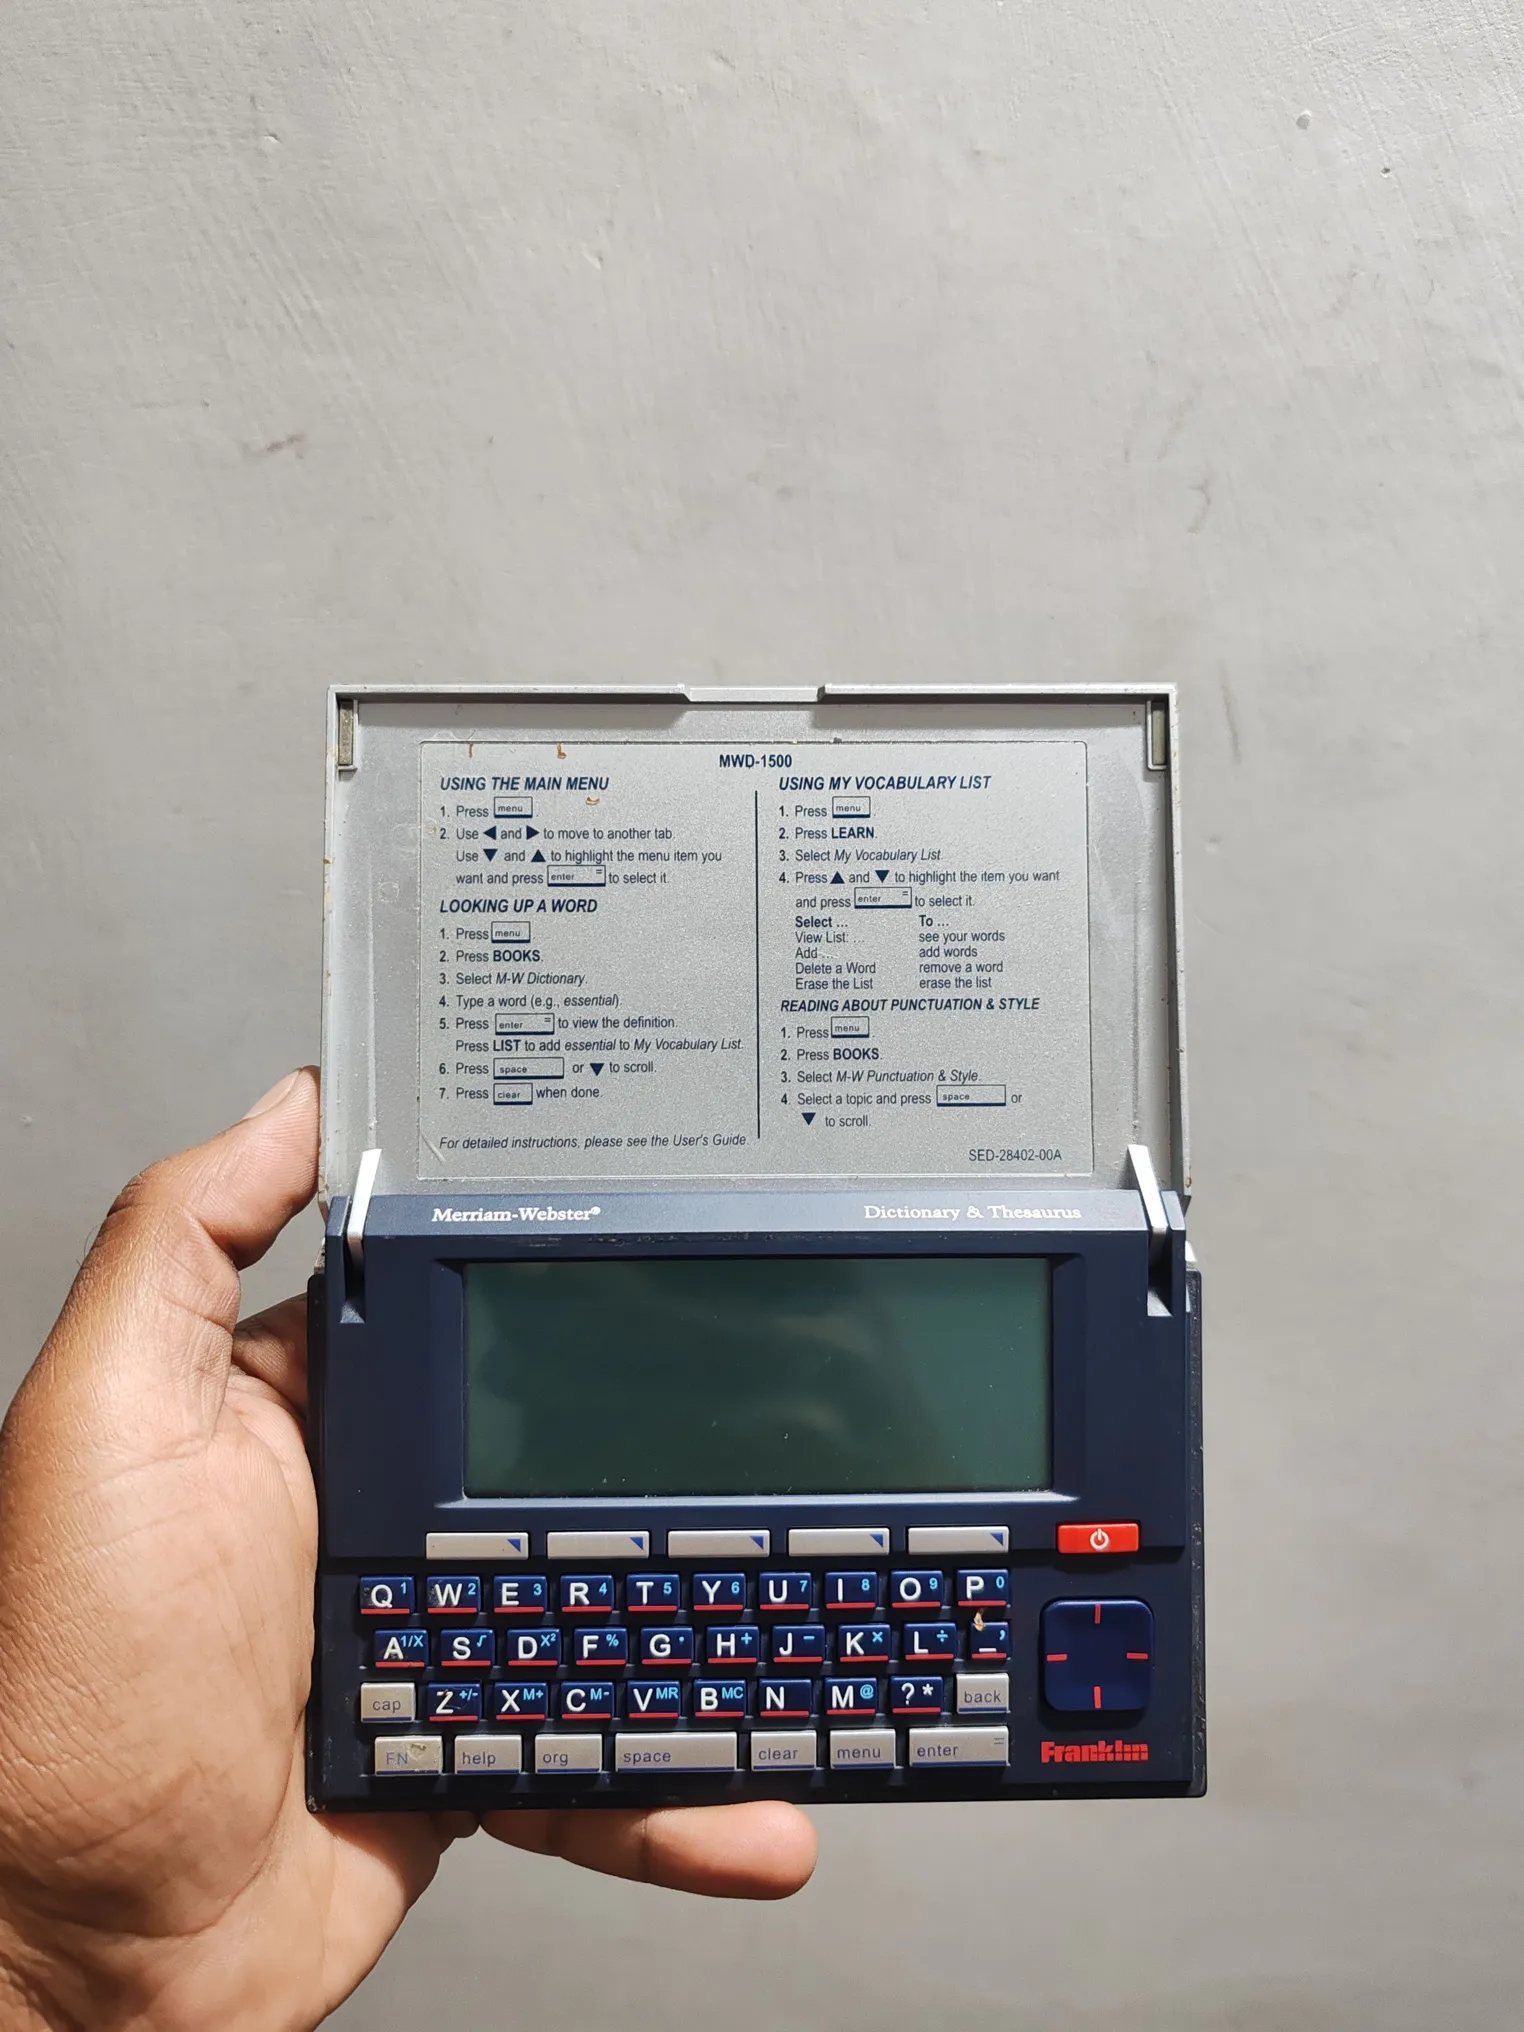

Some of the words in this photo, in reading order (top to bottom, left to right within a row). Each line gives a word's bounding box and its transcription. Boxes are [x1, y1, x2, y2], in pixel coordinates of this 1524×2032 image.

[719, 754, 793, 768] MWD-1500
[441, 777, 486, 790] USING
[491, 777, 520, 790] THE
[524, 777, 562, 790] MAIN
[566, 777, 609, 790] MENU
[779, 777, 824, 790] USING
[829, 777, 851, 790] MY
[855, 776, 956, 790] VOCABULARY
[959, 775, 991, 789] LIST
[456, 805, 489, 818] Press
[498, 805, 523, 813] menu
[795, 805, 827, 817] Press
[456, 828, 479, 840] Use
[501, 828, 522, 840] and
[558, 830, 590, 839] move
[607, 828, 651, 839] another
[654, 827, 676, 839] tab.
[795, 827, 827, 839] Press
[832, 827, 877, 839] LEARN.
[456, 850, 479, 862] Use
[504, 850, 526, 862] and
[565, 850, 614, 864] highlight
[617, 850, 634, 861] the
[638, 852, 670, 861] menu
[674, 850, 698, 861] item
[702, 852, 722, 864] you
[795, 850, 830, 861] Select
[834, 850, 851, 864] My
[855, 849, 917, 864] Vocabulary
[456, 873, 483, 884] want
[487, 873, 508, 884] and
[512, 875, 544, 887] press
[551, 873, 574, 881] enter
[623, 872, 657, 884] select
[796, 872, 828, 884] Press
[849, 872, 869, 883] and
[909, 870, 956, 885] highlight
[960, 871, 978, 882] the
[981, 870, 1005, 882] item
[1009, 873, 1029, 884] you
[1032, 871, 1060, 882] want
[441, 900, 509, 913] LOOKING
[513, 900, 536, 913] UP
[537, 900, 548, 912] A
[551, 899, 598, 913] WORD
[796, 897, 817, 908] and
[821, 898, 851, 910] press
[929, 895, 962, 907] select
[795, 916, 832, 928] Select
[919, 916, 933, 927] To
[456, 928, 489, 940] Press
[795, 932, 819, 943] View
[919, 933, 940, 942] see
[943, 933, 968, 945] your
[971, 931, 1005, 942] words
[456, 950, 489, 962] Press
[493, 949, 544, 962] BOOKS.
[795, 947, 818, 958] Add
[919, 946, 940, 958] add
[943, 946, 978, 958] words
[796, 963, 832, 974] Delete
[846, 963, 876, 974] Word
[919, 964, 962, 973] remove
[975, 961, 1003, 972] word
[456, 973, 492, 984] Select
[496, 972, 524, 984] M-W
[527, 972, 588, 987] Dictionary.
[796, 978, 828, 990] Erase
[832, 978, 850, 989] the
[853, 978, 873, 989] List
[919, 978, 952, 988] erase
[955, 977, 973, 988] the
[976, 977, 992, 988] list
[456, 995, 484, 1009] Type
[498, 995, 526, 1007] word
[531, 995, 560, 1009] (e.g.,
[781, 1000, 839, 1012] READING
[842, 999, 887, 1011] ABOUT
[891, 998, 982, 1011] PUNCTUATION
[986, 998, 995, 1010] &
[999, 998, 1040, 1010] STYLE
[456, 1018, 489, 1030] Press
[572, 1017, 599, 1028] view
[602, 1017, 620, 1028] the
[623, 1016, 678, 1028] definition.
[797, 1027, 829, 1039] Press
[456, 1040, 489, 1052] Press
[493, 1039, 521, 1051] LIST
[539, 1039, 560, 1051] add
[564, 1039, 616, 1051] essential
[634, 1039, 652, 1053] My
[655, 1038, 718, 1052] Vocabulary
[797, 1049, 829, 1061] Press
[833, 1048, 883, 1060] BOOKS.
[456, 1063, 489, 1074] Press
[500, 1066, 527, 1074] space
[623, 1062, 657, 1073] scroll.
[797, 1071, 832, 1083] Select
[836, 1071, 864, 1083] M-W
[867, 1070, 934, 1082] Punctuation
[938, 1071, 946, 1082] &
[950, 1070, 982, 1084] Style.
[456, 1088, 489, 1099] Press
[498, 1091, 521, 1099] clear
[536, 1087, 567, 1098] when
[571, 1086, 603, 1098] done.
[798, 1093, 833, 1105] Select
[846, 1092, 873, 1107] topic
[876, 1092, 897, 1104] and
[900, 1094, 931, 1106] press
[839, 1115, 871, 1127] scroll.
[439, 1137, 459, 1149] For
[462, 1137, 508, 1149] detailed
[511, 1136, 580, 1150] instructions,
[584, 1136, 623, 1150] please
[626, 1137, 648, 1147] see
[651, 1135, 669, 1146] the
[672, 1134, 708, 1146] User's
[712, 1134, 748, 1146] Guide.
[969, 1149, 1062, 1162] SED-28402-00A
[864, 1205, 960, 1222] Dictionary
[966, 1206, 983, 1219] &
[987, 1205, 1082, 1219] Thesaurus
[434, 1583, 462, 1606] W
[501, 1582, 519, 1606] E
[569, 1582, 590, 1606] R
[636, 1581, 654, 1605] T
[702, 1580, 721, 1604] Y
[769, 1580, 787, 1603] U
[837, 1579, 843, 1602] I
[900, 1577, 921, 1601] O
[966, 1576, 985, 1599] P
[371, 1584, 393, 1608] Q
[964, 1690, 1001, 1703] back
[373, 1699, 401, 1712] cap
[758, 1748, 798, 1760] clear
[837, 1747, 881, 1759] menu
[917, 1744, 958, 1757] enter
[462, 1752, 496, 1768] help
[543, 1752, 568, 1768] org
[623, 1751, 671, 1766] space
